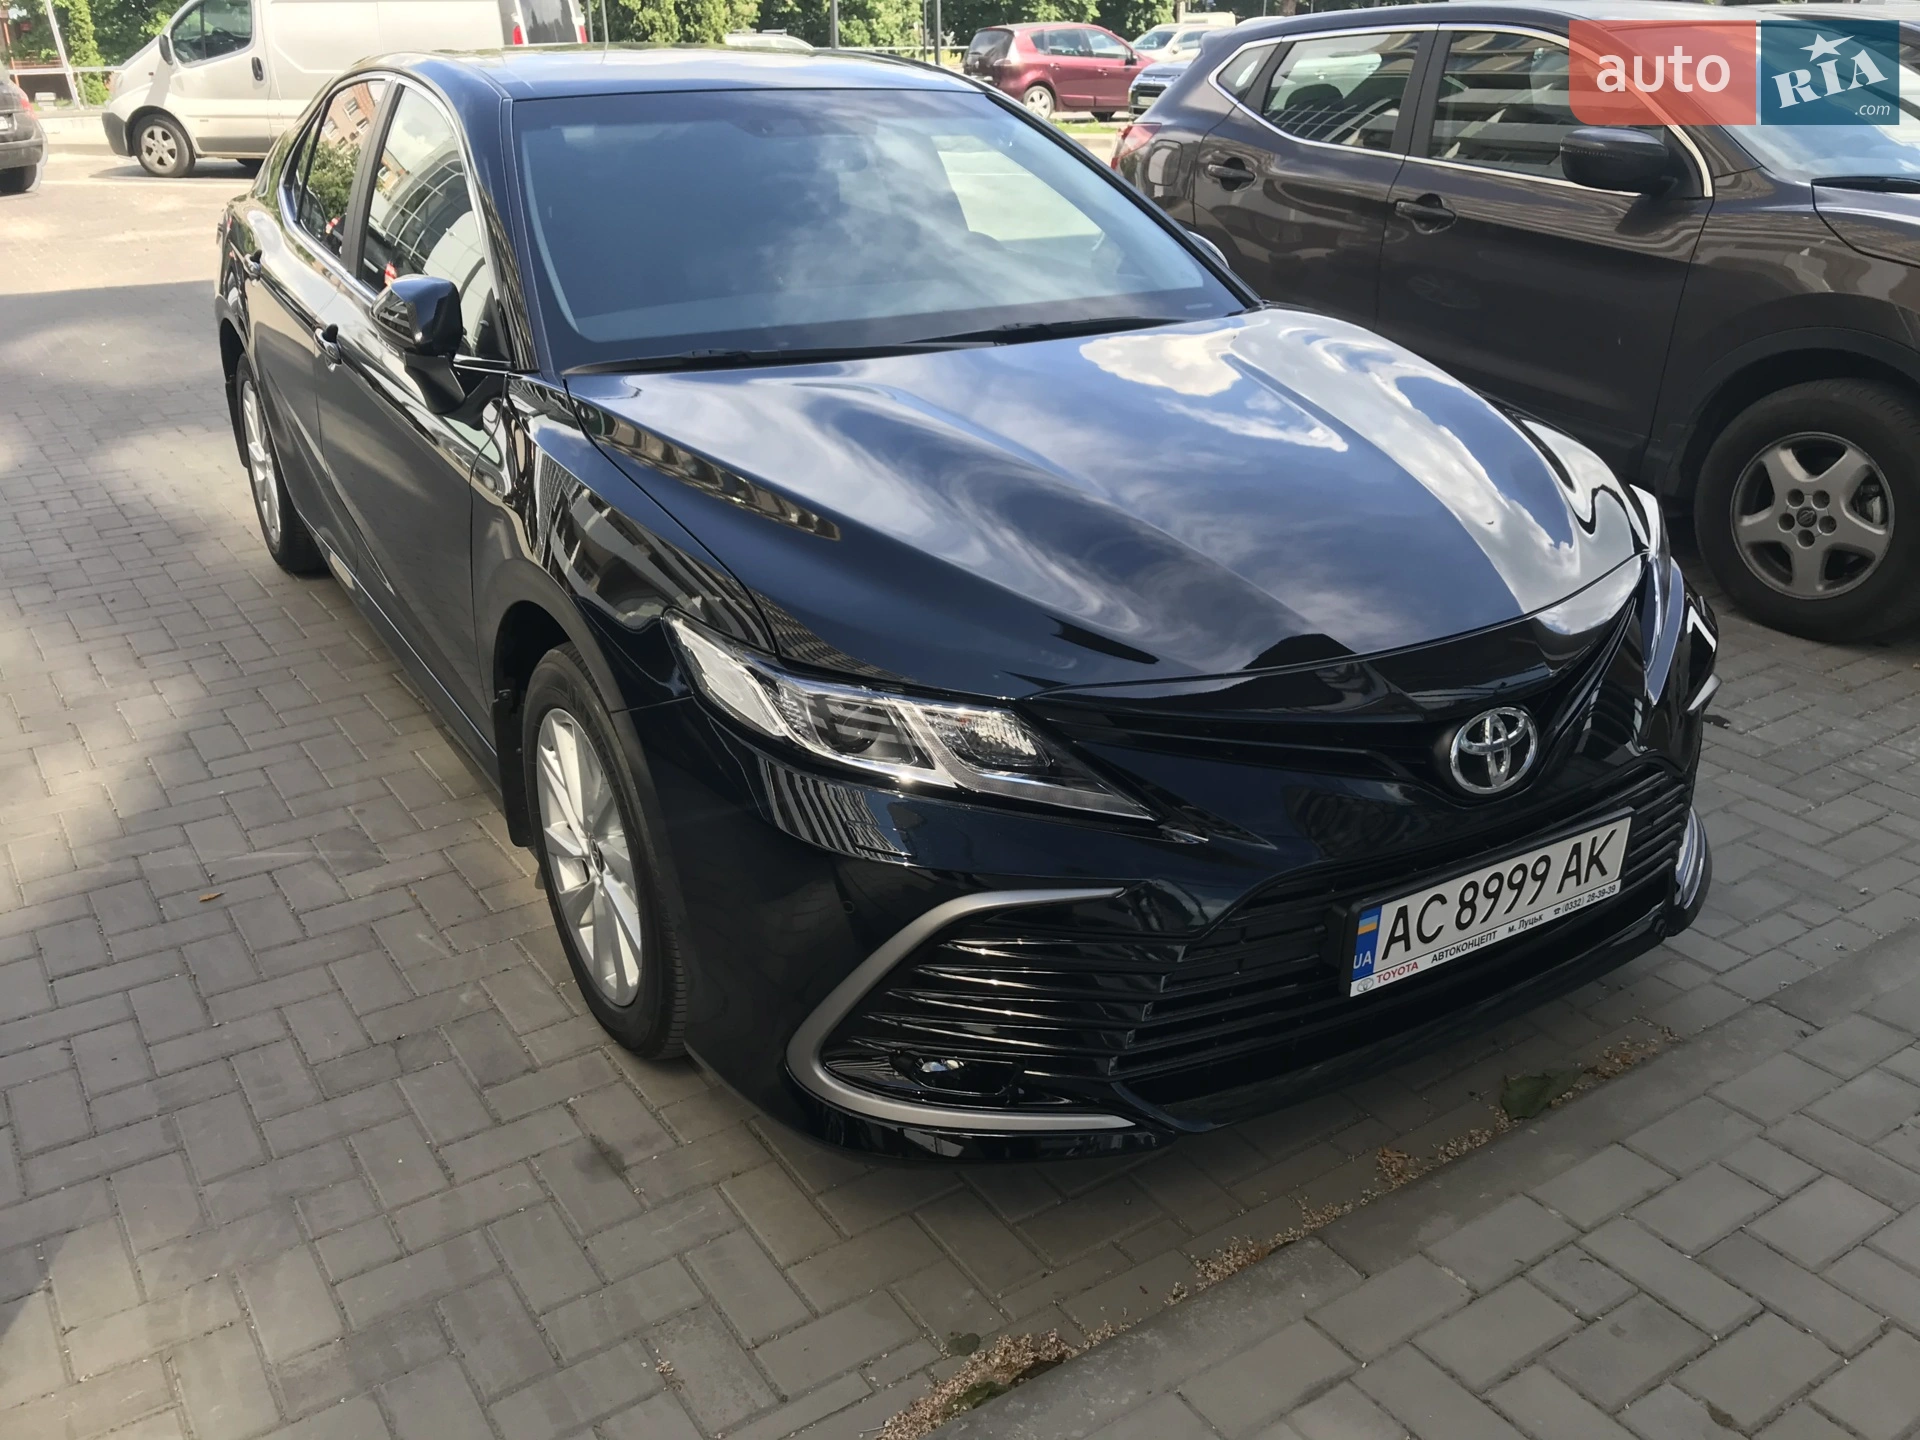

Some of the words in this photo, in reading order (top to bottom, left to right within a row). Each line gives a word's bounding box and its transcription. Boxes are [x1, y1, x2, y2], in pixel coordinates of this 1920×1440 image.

[1381, 893, 1448, 961] AC
[1454, 854, 1552, 931] 8999
[1555, 828, 1618, 894] AK
[1353, 950, 1372, 970] UA
[1376, 961, 1419, 983] TOYOTA
[1431, 930, 1498, 963] АВТОКОНЦЕПТ
